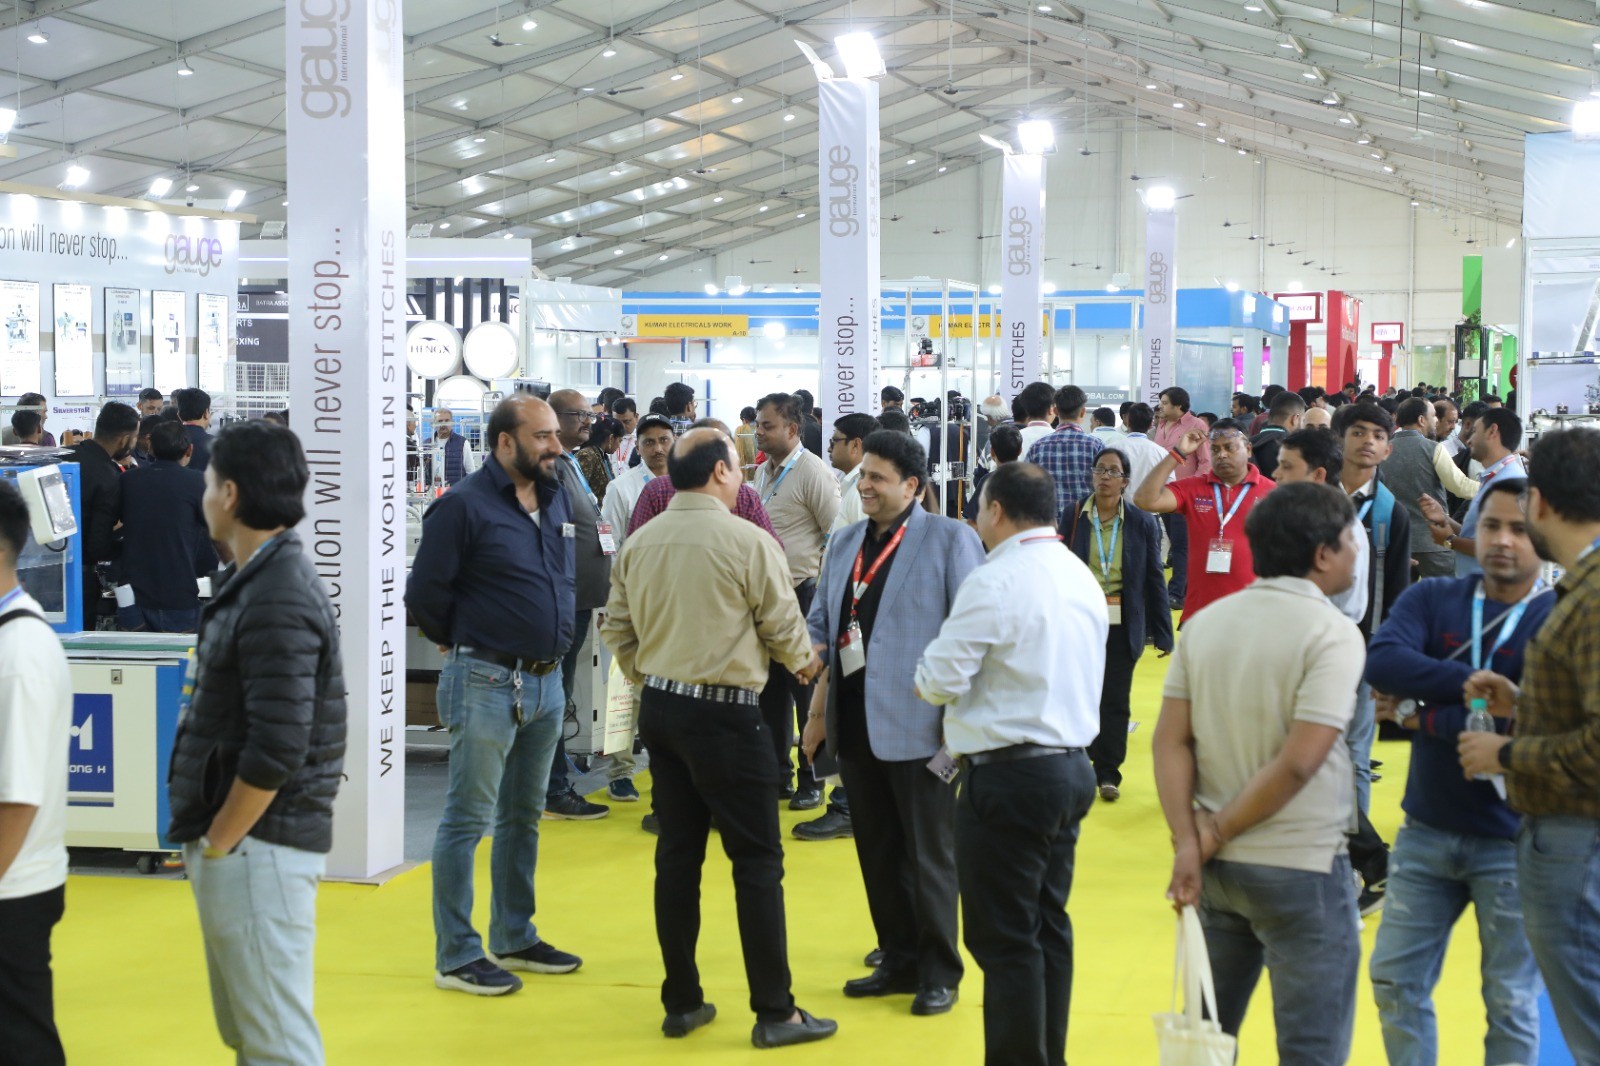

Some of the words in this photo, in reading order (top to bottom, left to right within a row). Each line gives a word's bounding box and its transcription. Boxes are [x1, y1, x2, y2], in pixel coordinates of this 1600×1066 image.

[339, 25, 348, 81] International
[829, 145, 860, 237] gauge
[21, 223, 44, 253] will
[50, 232, 85, 256] never
[89, 232, 128, 265] stop...
[164, 234, 222, 277] gauge
[1008, 206, 1032, 276] gauge
[307, 228, 349, 330] stop...
[382, 230, 395, 382] STITCHES
[1149, 251, 1168, 304] gauge
[834, 297, 859, 356] stop...
[1011, 321, 1025, 389] STITCHES
[314, 343, 342, 433] never
[838, 363, 855, 414] never
[1150, 338, 1161, 388] STITCHES
[382, 396, 395, 428] IN
[306, 450, 341, 505] will
[382, 441, 395, 556] WORLD
[381, 567, 394, 630] THE
[381, 640, 394, 715] KEEP
[380, 726, 393, 778] WE
